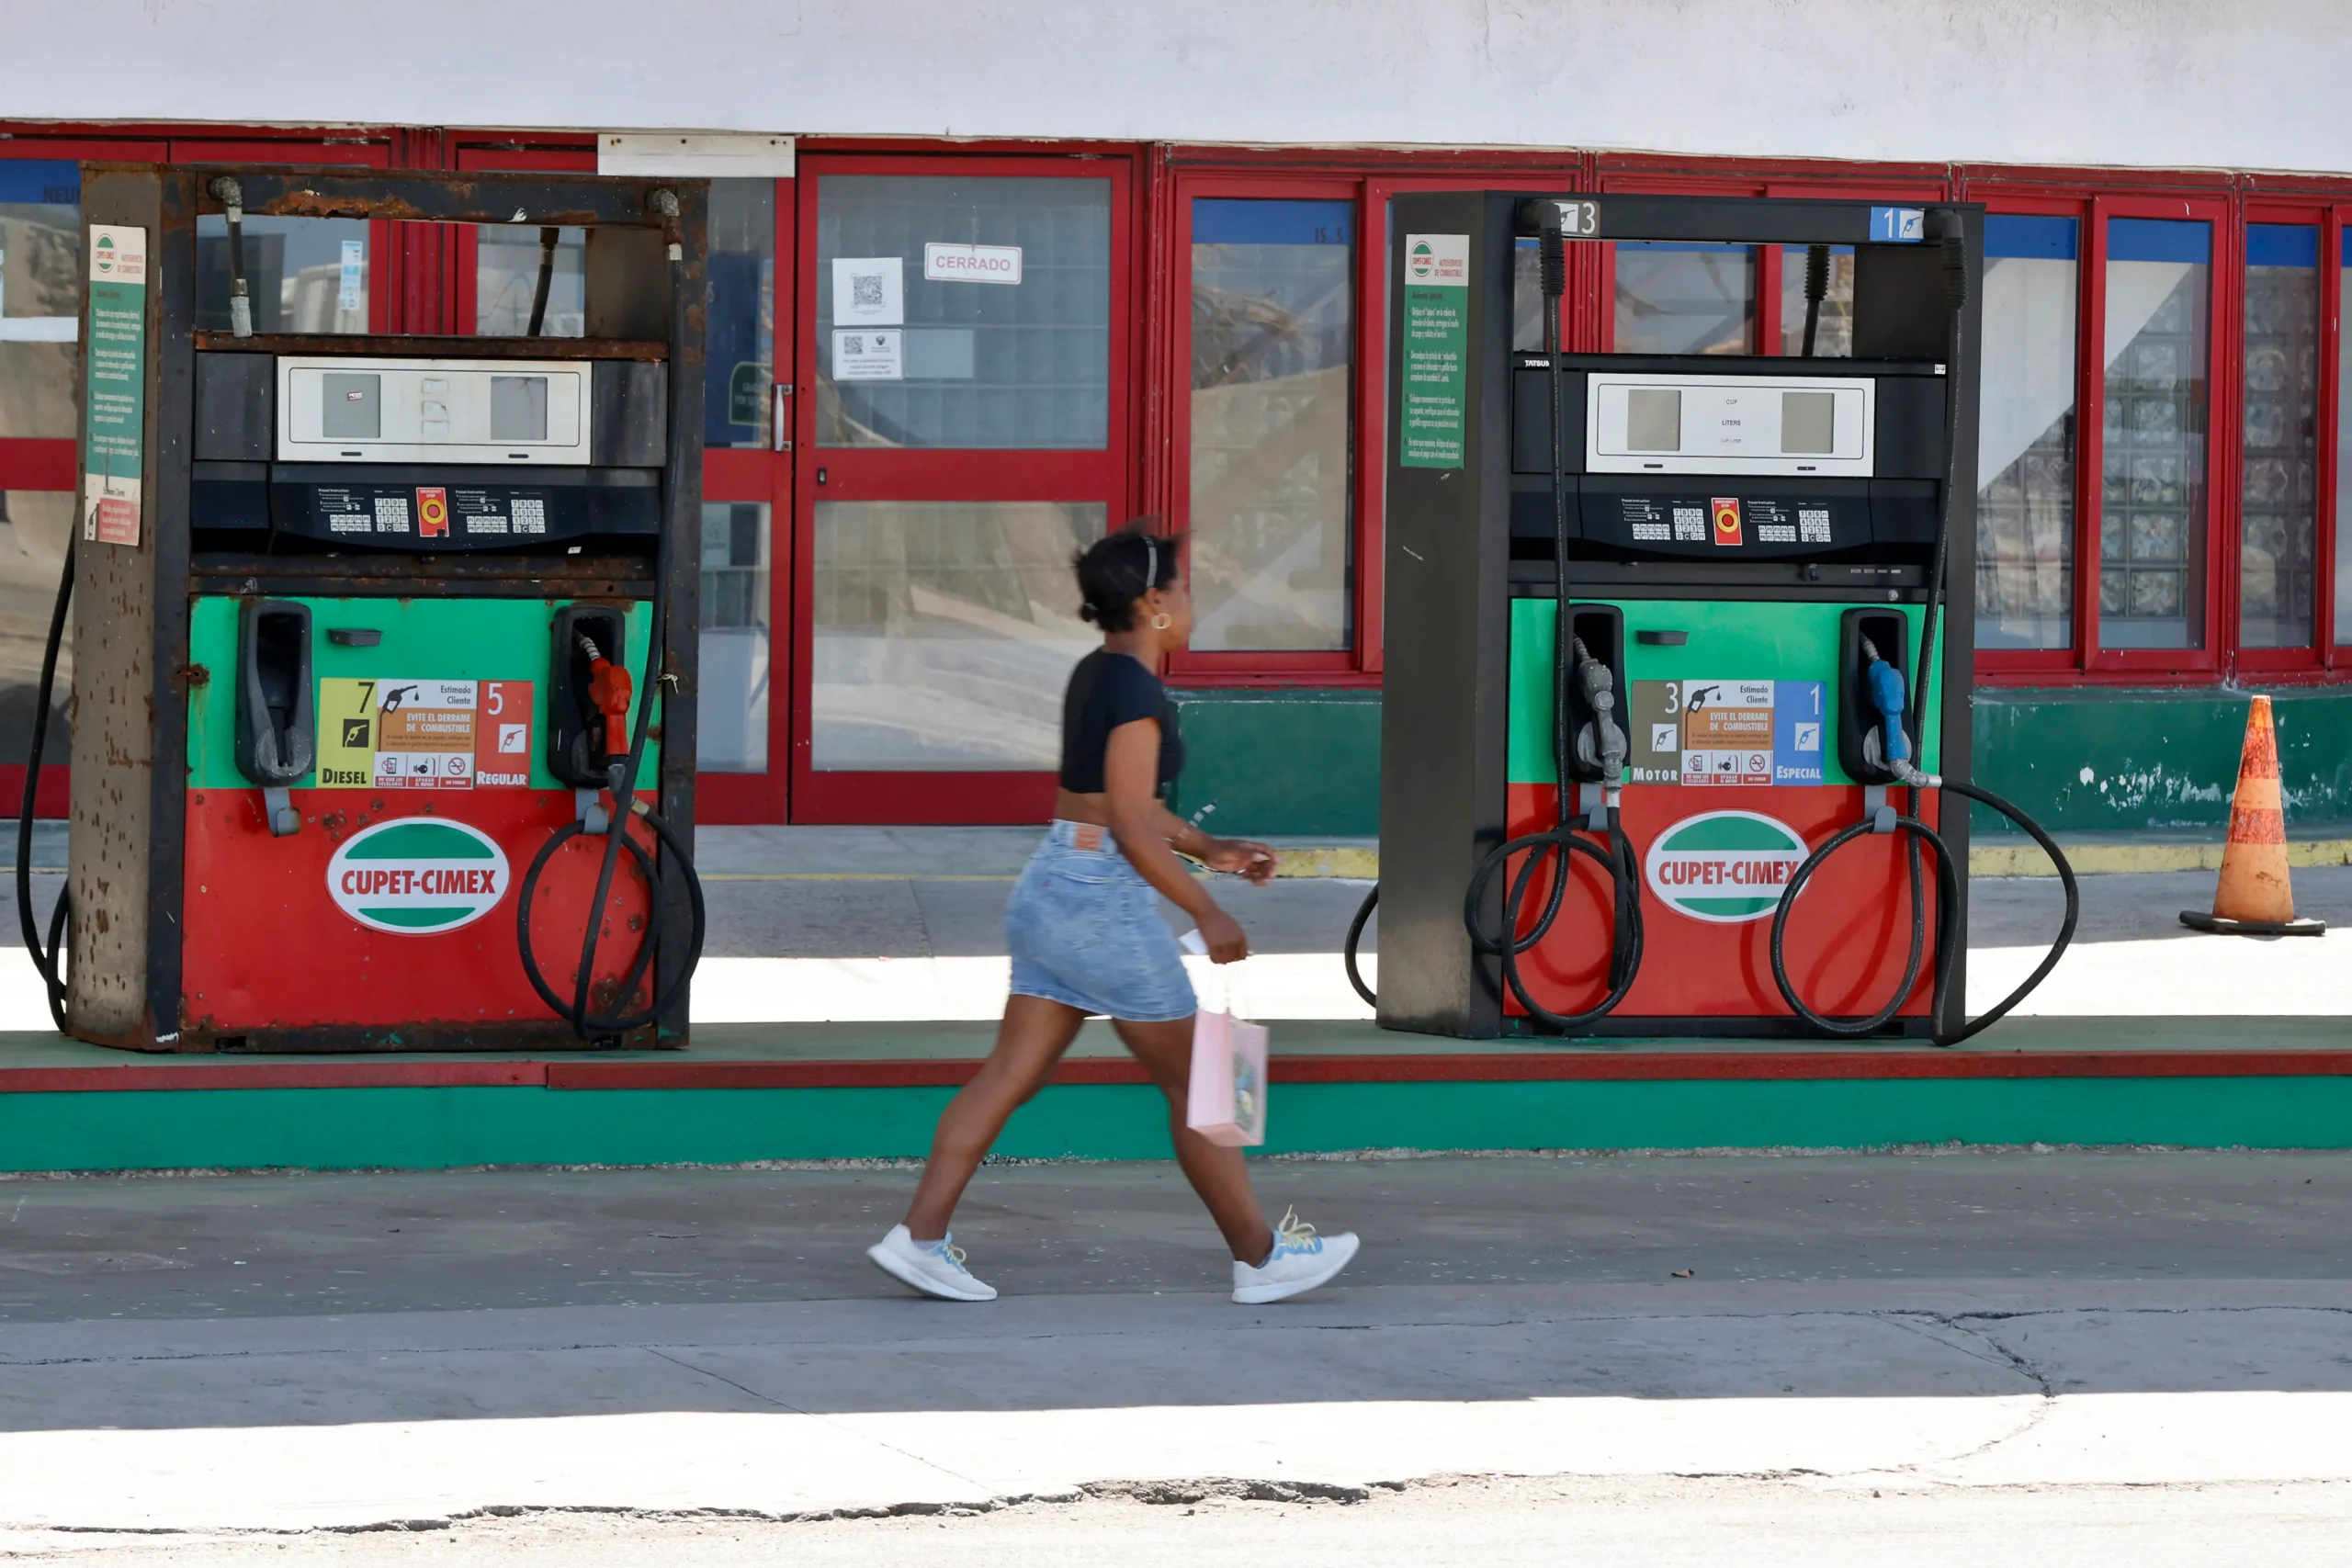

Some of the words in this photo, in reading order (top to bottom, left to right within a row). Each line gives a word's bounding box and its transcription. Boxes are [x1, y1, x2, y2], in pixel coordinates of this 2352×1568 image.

[1581, 202, 1595, 234] 3
[1884, 208, 1893, 238] 1
[935, 255, 1011, 271] CERRADO
[1524, 359, 1550, 367] TATSUN
[440, 685, 471, 694] Estimado
[1740, 685, 1768, 694] Estimado
[358, 682, 375, 713] 7
[447, 696, 471, 705] Cliente
[487, 682, 503, 715] 5
[1665, 682, 1678, 714] 3
[1746, 695, 1768, 703] Cliente
[1810, 684, 1820, 715] 1
[407, 713, 426, 722] EVITE
[428, 713, 436, 722] EL
[437, 713, 471, 722] DERRAME
[1710, 712, 1728, 721] EVITE
[1729, 712, 1737, 721] EL
[1738, 712, 1768, 721] DERRAME
[406, 723, 416, 732] DE
[421, 724, 470, 733] COMBUSTIBLE
[1710, 722, 1719, 731] DE
[1723, 722, 1768, 731] COMBUSTIBLE
[322, 768, 367, 784] DIESEL
[476, 771, 526, 785] REGULAR
[1633, 767, 1677, 781] MOTOR
[1776, 765, 1821, 779] ESPECIAL
[1659, 861, 1799, 885] CUPET-CIMEX
[341, 869, 496, 895] CUPET-CIMEX
